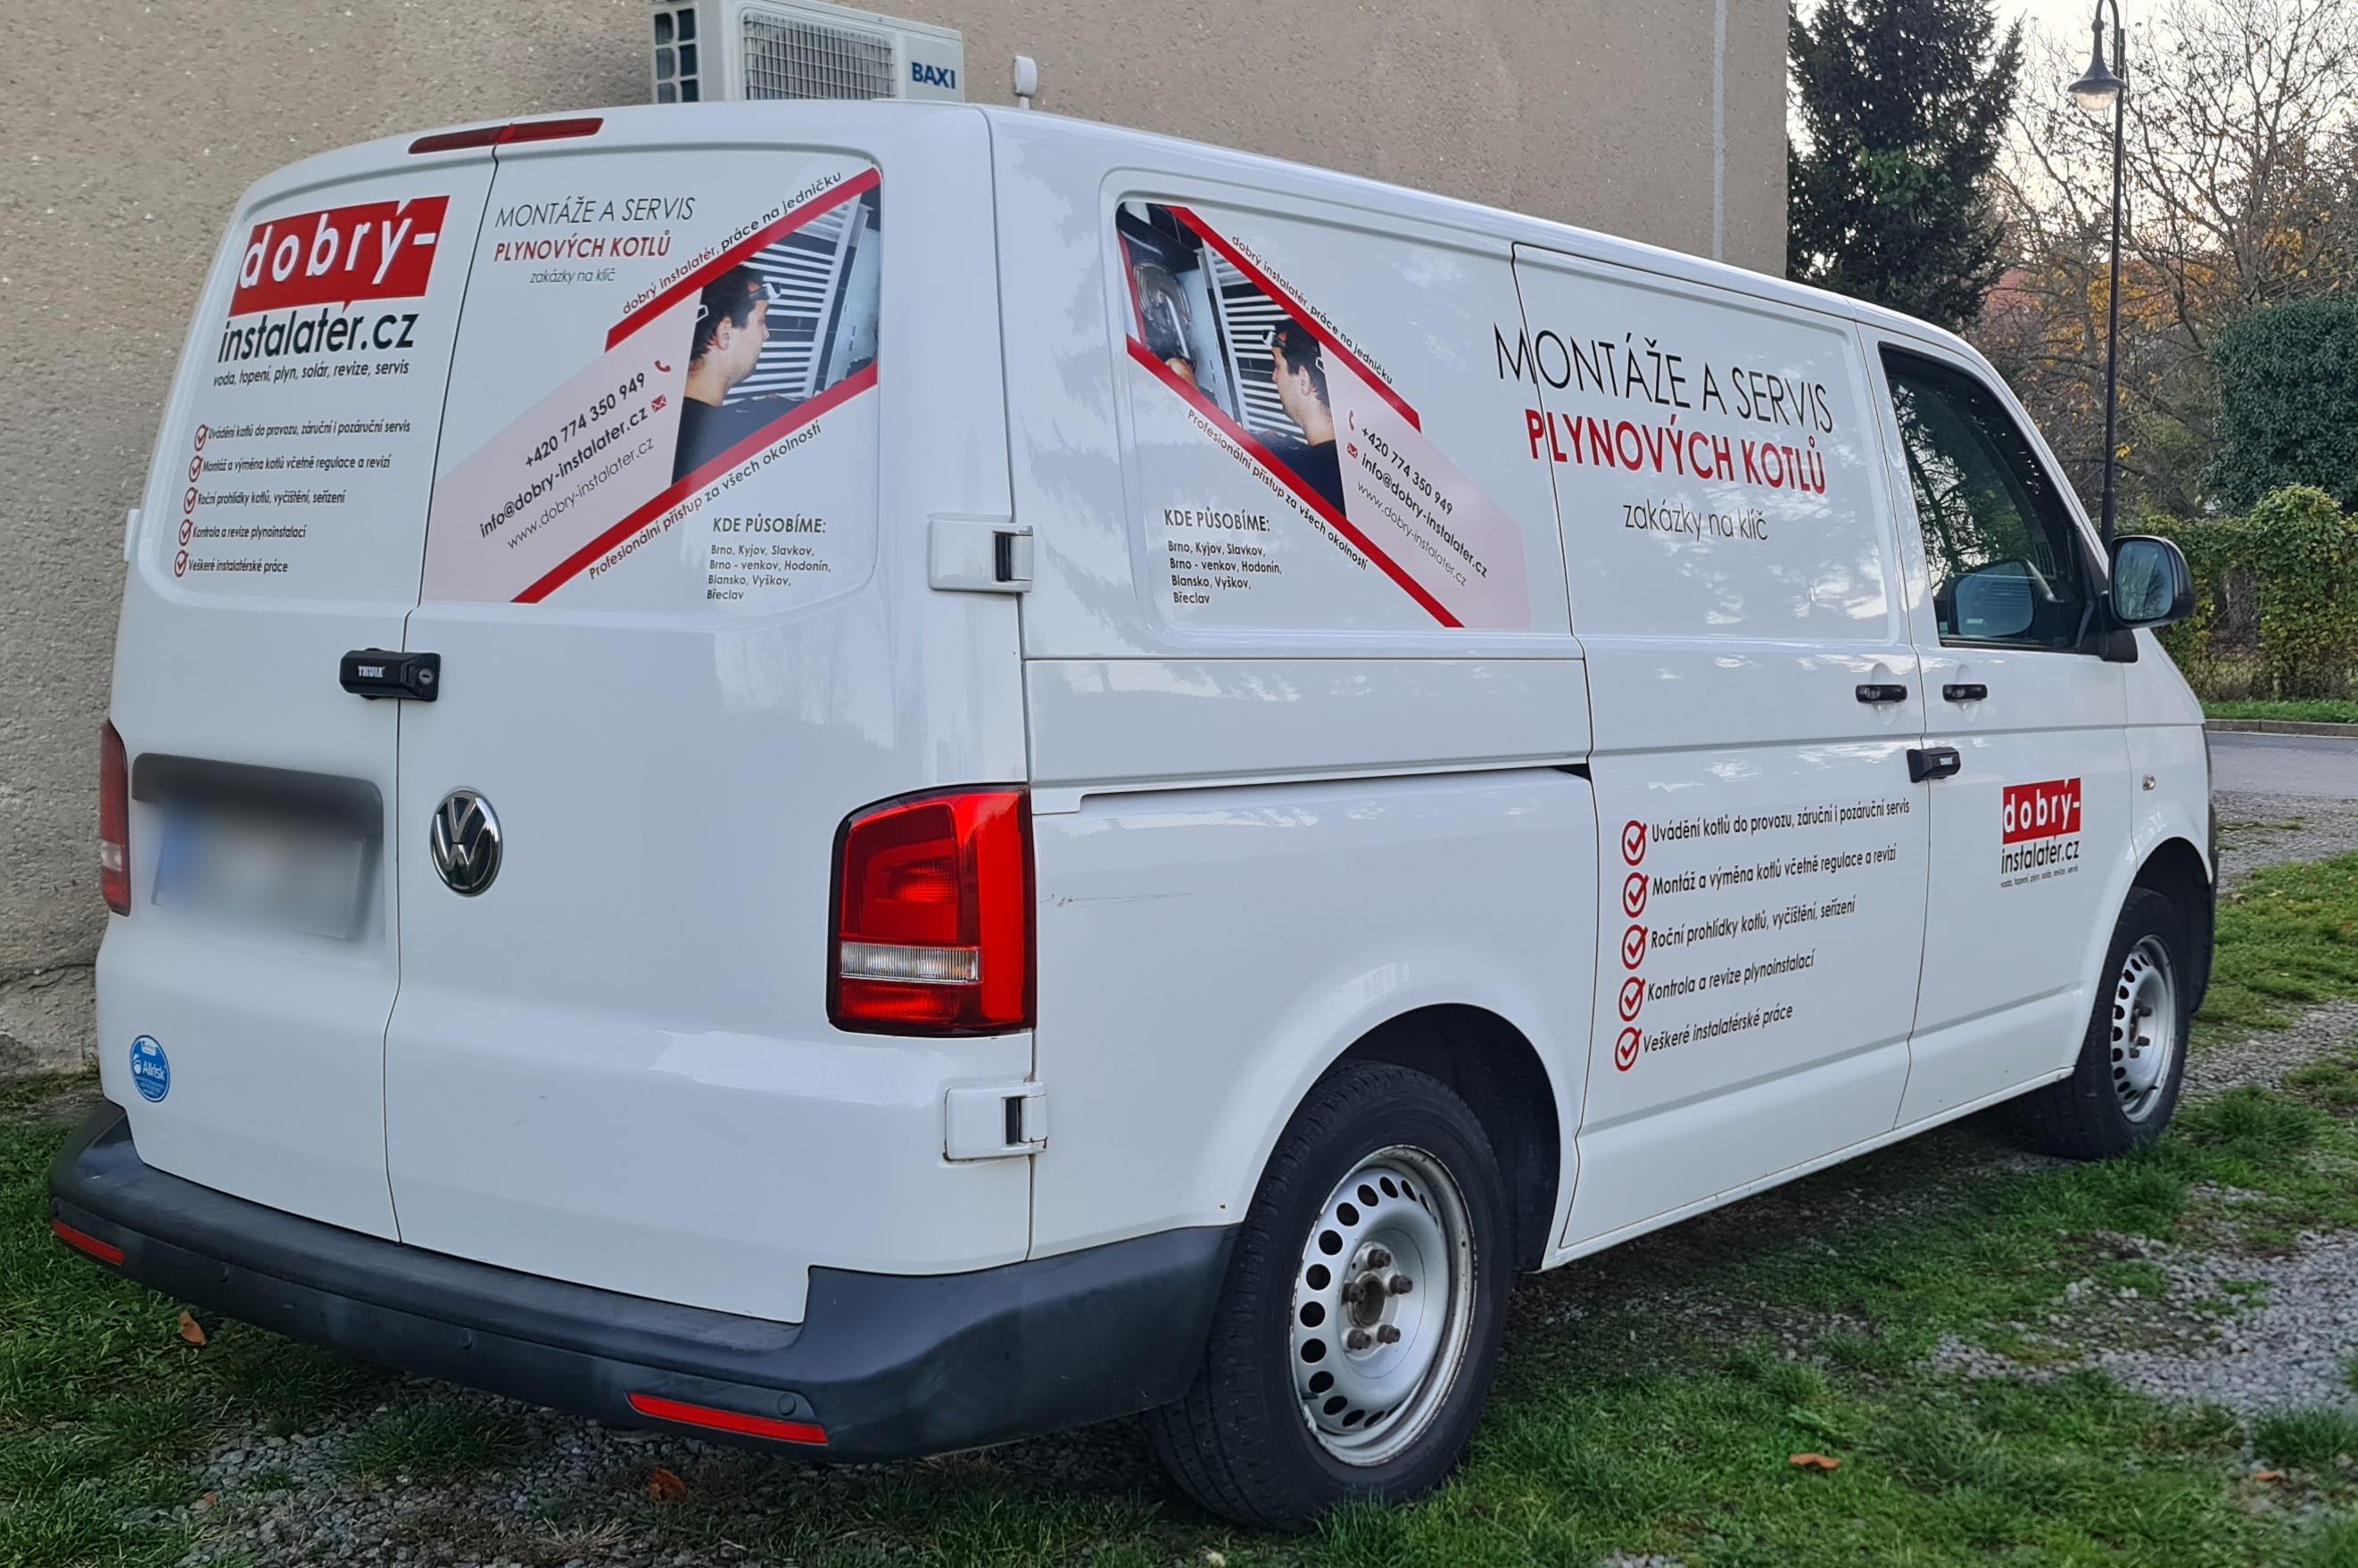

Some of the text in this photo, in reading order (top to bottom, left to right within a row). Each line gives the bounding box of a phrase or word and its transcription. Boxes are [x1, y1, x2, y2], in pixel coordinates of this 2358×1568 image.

[911, 62, 956, 88] BAXI
[495, 196, 695, 227] MONTÁŽE A SERVIS
[494, 230, 671, 261] PLYNOVÝCH KOTLŮ
[624, 172, 841, 314] dobrý instalatér, práce na jedničku
[529, 268, 616, 285] zakázky na klíč
[1232, 236, 1393, 384] dobrý instalatér, práce na jedničku
[214, 359, 410, 386] voda, topení, plyn, solár, revize, servis
[1493, 323, 1833, 433] MONTÁŽE A SERVIS
[525, 373, 645, 466] +420 774 350 949
[228, 462, 232, 470] a
[358, 459, 364, 467] a
[1361, 428, 1452, 515] +420 774 350 949
[1526, 409, 1826, 494] PLYNOVÝCH KOTLŮ
[480, 408, 648, 538] info@dobry-instalater.cz
[508, 438, 654, 549] www.dobry-instalater.cz
[1187, 409, 1369, 571] Profesionální přístup za všech okolností
[590, 420, 822, 579] Profesionální přístup za všech okolností
[1164, 507, 1270, 532] KDE PŮSOBÍME:
[1361, 453, 1488, 578] info@dobry-instalater.cz
[1623, 499, 1767, 541] zakázky na klíč
[221, 528, 226, 537] a
[714, 513, 826, 532] KDE PŮSOBÍME:
[1358, 481, 1467, 587] www.dobry-instalater.cz
[709, 560, 731, 569] Brno
[741, 560, 781, 571] venkov,
[784, 560, 831, 572] Hodonín,
[711, 544, 815, 557] Brno, Kyjov, Slavkov,
[1169, 541, 1265, 557] Brno, Kyjov, Slavkov,
[1170, 557, 1191, 569] Brno
[1202, 560, 1239, 573] venkov,
[1242, 561, 1282, 574] Hodonín,
[707, 589, 743, 599] Břeclav
[708, 574, 791, 587] Blansko, Vyškov,
[1171, 575, 1251, 590] Blansko, Vyškov,
[1173, 591, 1210, 604] Břeclav
[1652, 797, 1909, 842] Uvádění kotlů do provozu, záruční i pozáruční servis
[1652, 843, 1897, 895] Montáž a výměna kotlů včetně regulace a revizí
[1651, 895, 1856, 949] Roční prohlídky kotlů, vyčištění, seřízení
[1648, 949, 1816, 1002] Kontrola a revize plynoinstalací
[1643, 1003, 1792, 1053] Veškeré instalatérské práce
